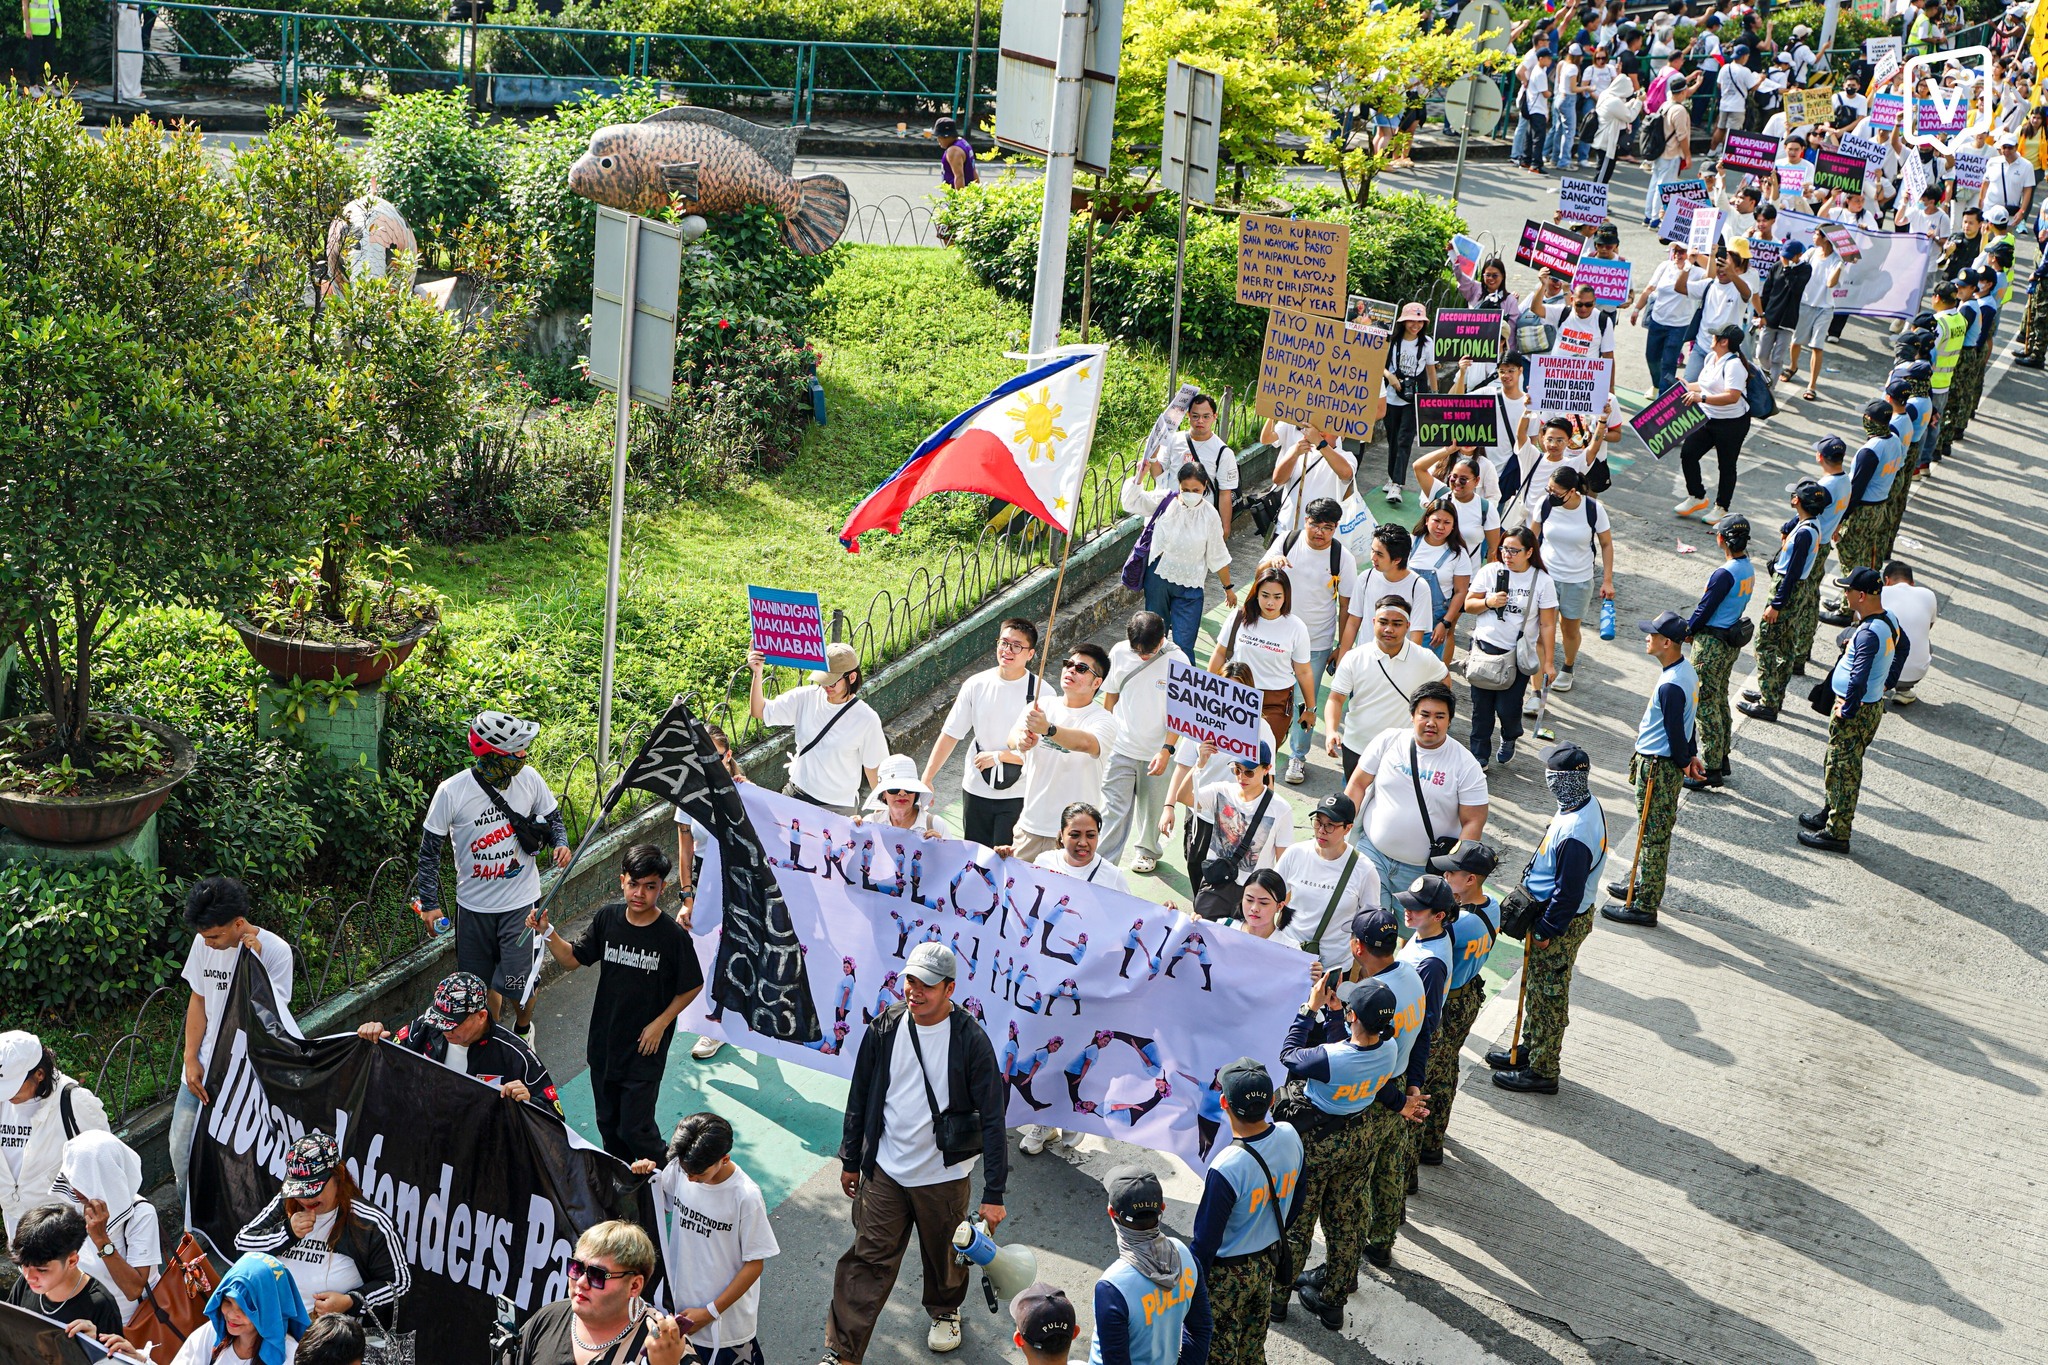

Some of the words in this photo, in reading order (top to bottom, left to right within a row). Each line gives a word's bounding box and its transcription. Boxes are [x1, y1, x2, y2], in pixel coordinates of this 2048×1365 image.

[1730, 136, 1775, 150] PINAPATAY
[1844, 134, 1872, 150] LAHAT
[1874, 144, 1887, 156] NG
[1723, 153, 1774, 169] KATIWALIAN
[1840, 145, 1884, 165] SANGKOT
[1955, 153, 1984, 164] LAHAT
[1562, 180, 1591, 192] LAHAT
[1593, 185, 1607, 195] NG
[1662, 184, 1678, 192] YOU
[1679, 182, 1700, 191] CAN'T
[1814, 172, 1861, 193] OPTIONAL
[1560, 190, 1606, 206] SANGKOT
[1246, 220, 1259, 232] SA
[1264, 223, 1283, 235] MGA
[1290, 227, 1340, 242] KURAKOT:
[1541, 230, 1580, 251] PINAPATAY
[1264, 238, 1300, 251] NGAYONG
[1305, 242, 1333, 255] PASKO
[1544, 245, 1558, 254] TAYO
[1243, 248, 1254, 258] AY
[1258, 250, 1326, 268] MAIPAKULONG
[1532, 250, 1576, 273] KATIWALIAN
[1244, 262, 1258, 272] NA
[1266, 264, 1283, 276] RIN
[1294, 269, 1322, 281] KAYO
[1574, 274, 1627, 287] MAKIALAM
[1243, 275, 1274, 288] MERRY
[1277, 280, 1334, 297] CHRISTMAS
[1242, 290, 1273, 304] HAPPY
[1278, 294, 1306, 307] NEW
[1310, 298, 1336, 313] YEAR
[1439, 312, 1500, 323] ACCOUNTABILITY
[1274, 310, 1307, 331] TAYO
[1315, 322, 1334, 340] NA
[1344, 330, 1383, 350] LANG
[1349, 322, 1367, 332] KARA
[1368, 326, 1388, 336] DAVID
[1456, 325, 1464, 334] IS
[1466, 326, 1480, 334] NOT
[1271, 330, 1325, 356] TUMUPAD
[1332, 345, 1350, 361] SA
[1435, 338, 1497, 359] OPTIONAL
[1267, 346, 1320, 371] BIRTHDAY
[1328, 363, 1368, 382] WISH
[1539, 357, 1585, 370] PUMAPATAY
[1588, 361, 1604, 371] ANG
[1264, 364, 1277, 377] NI
[1289, 370, 1322, 389] KARA
[1329, 380, 1369, 400] DAVID
[1545, 369, 1595, 380] KATIWALIAN.
[1544, 379, 1566, 389] HINDI
[1568, 381, 1595, 391] BAGYO
[1263, 380, 1301, 400] HAPPY
[1307, 392, 1367, 417] BIRTHDAY
[1419, 399, 1494, 409] ACCOUNTABILITY
[1545, 390, 1568, 400] HINDI
[1570, 391, 1591, 401] BAHA
[1541, 399, 1563, 410] HINDI
[1565, 401, 1593, 412] LINDOL
[1633, 385, 1686, 428] ACCOUNTABILITY
[1274, 401, 1313, 423] SHOT
[1325, 415, 1368, 436] PUNO
[1443, 412, 1453, 420] IS
[1455, 412, 1471, 420] NOT
[1656, 416, 1665, 426] IS
[1663, 407, 1677, 419] NOT
[1420, 423, 1496, 443] OPTIONAL
[1648, 406, 1705, 454] OPTIONAL
[751, 599, 818, 619] MANINDIGAN
[752, 616, 821, 637] MAKIALAM
[754, 634, 823, 658] LUMABAN
[1170, 663, 1229, 694] LAHAT
[1233, 686, 1259, 709] NG
[1167, 686, 1258, 728] SANGKOT
[1196, 713, 1227, 731] DAPAT
[1167, 715, 1258, 762] MANAGOT!
[1433, 778, 1445, 786] QC
[1434, 771, 1446, 779] D2
[473, 849, 514, 860] WALANG
[471, 862, 505, 881] BAHA
[1380, 923, 1399, 933] PULIS
[505, 974, 526, 990] 24
[208, 1028, 321, 1181] Ilocan
[1246, 1091, 1267, 1101] PULIS
[1, 1137, 24, 1148] PARTY
[1132, 1202, 1158, 1210] PULIS
[689, 1209, 733, 1231] DEFENDERS
[305, 1253, 325, 1264] LIST
[1142, 1267, 1196, 1326] PULIS
[1042, 1322, 1068, 1334] PULIS
